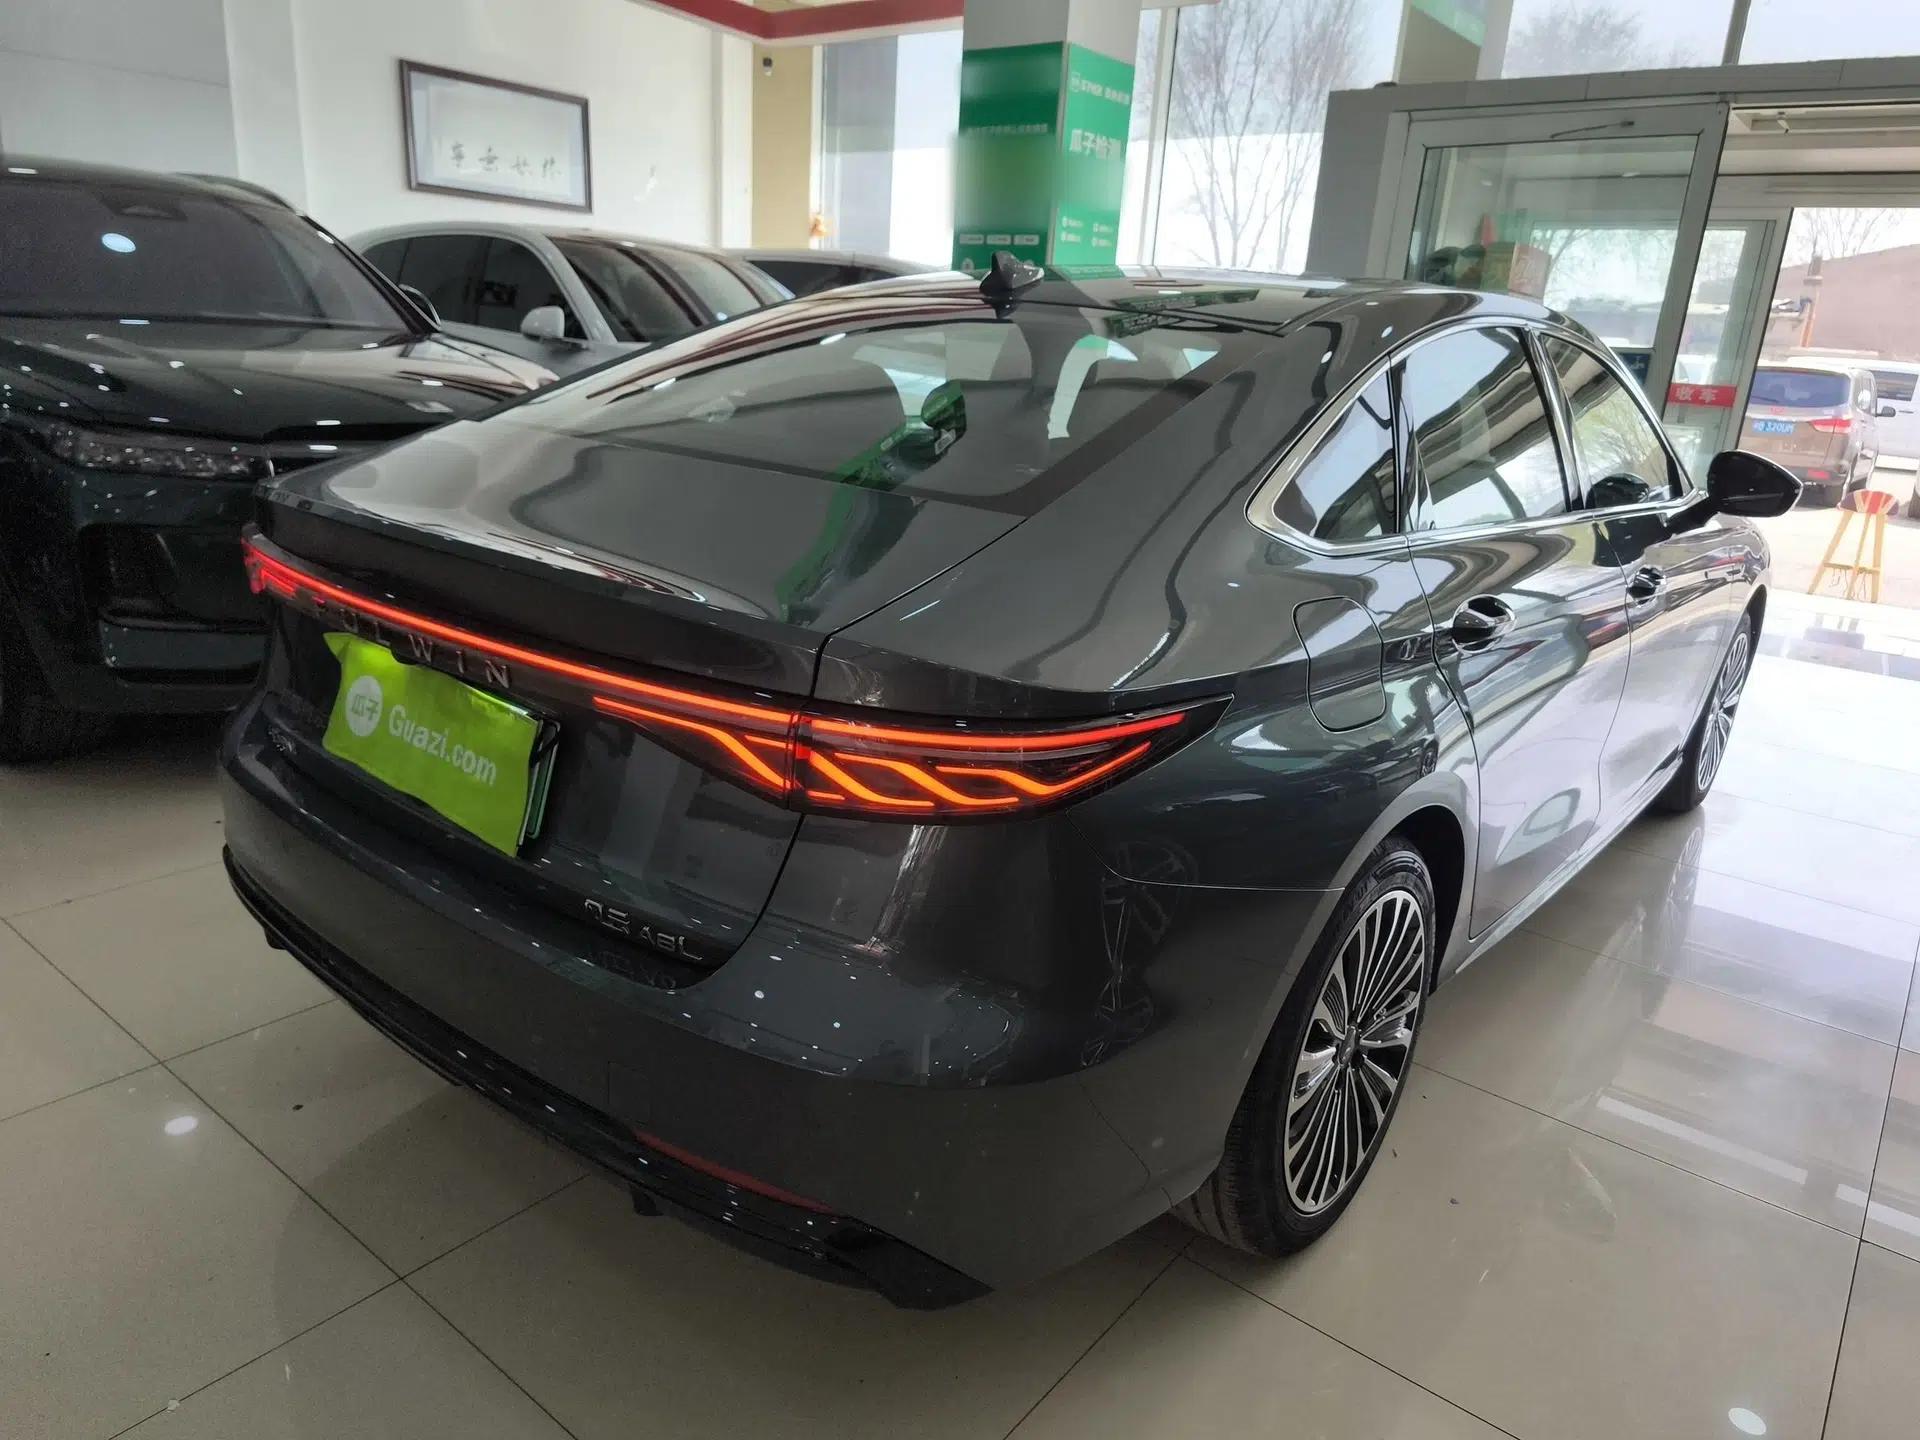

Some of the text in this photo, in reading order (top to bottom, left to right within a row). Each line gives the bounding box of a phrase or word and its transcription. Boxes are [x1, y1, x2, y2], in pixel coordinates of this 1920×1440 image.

[1070, 129, 1121, 159] 瓜子检
[350, 694, 379, 722] 瓜子
[388, 704, 497, 788] Guazi.com
[640, 925, 703, 961] A8L
